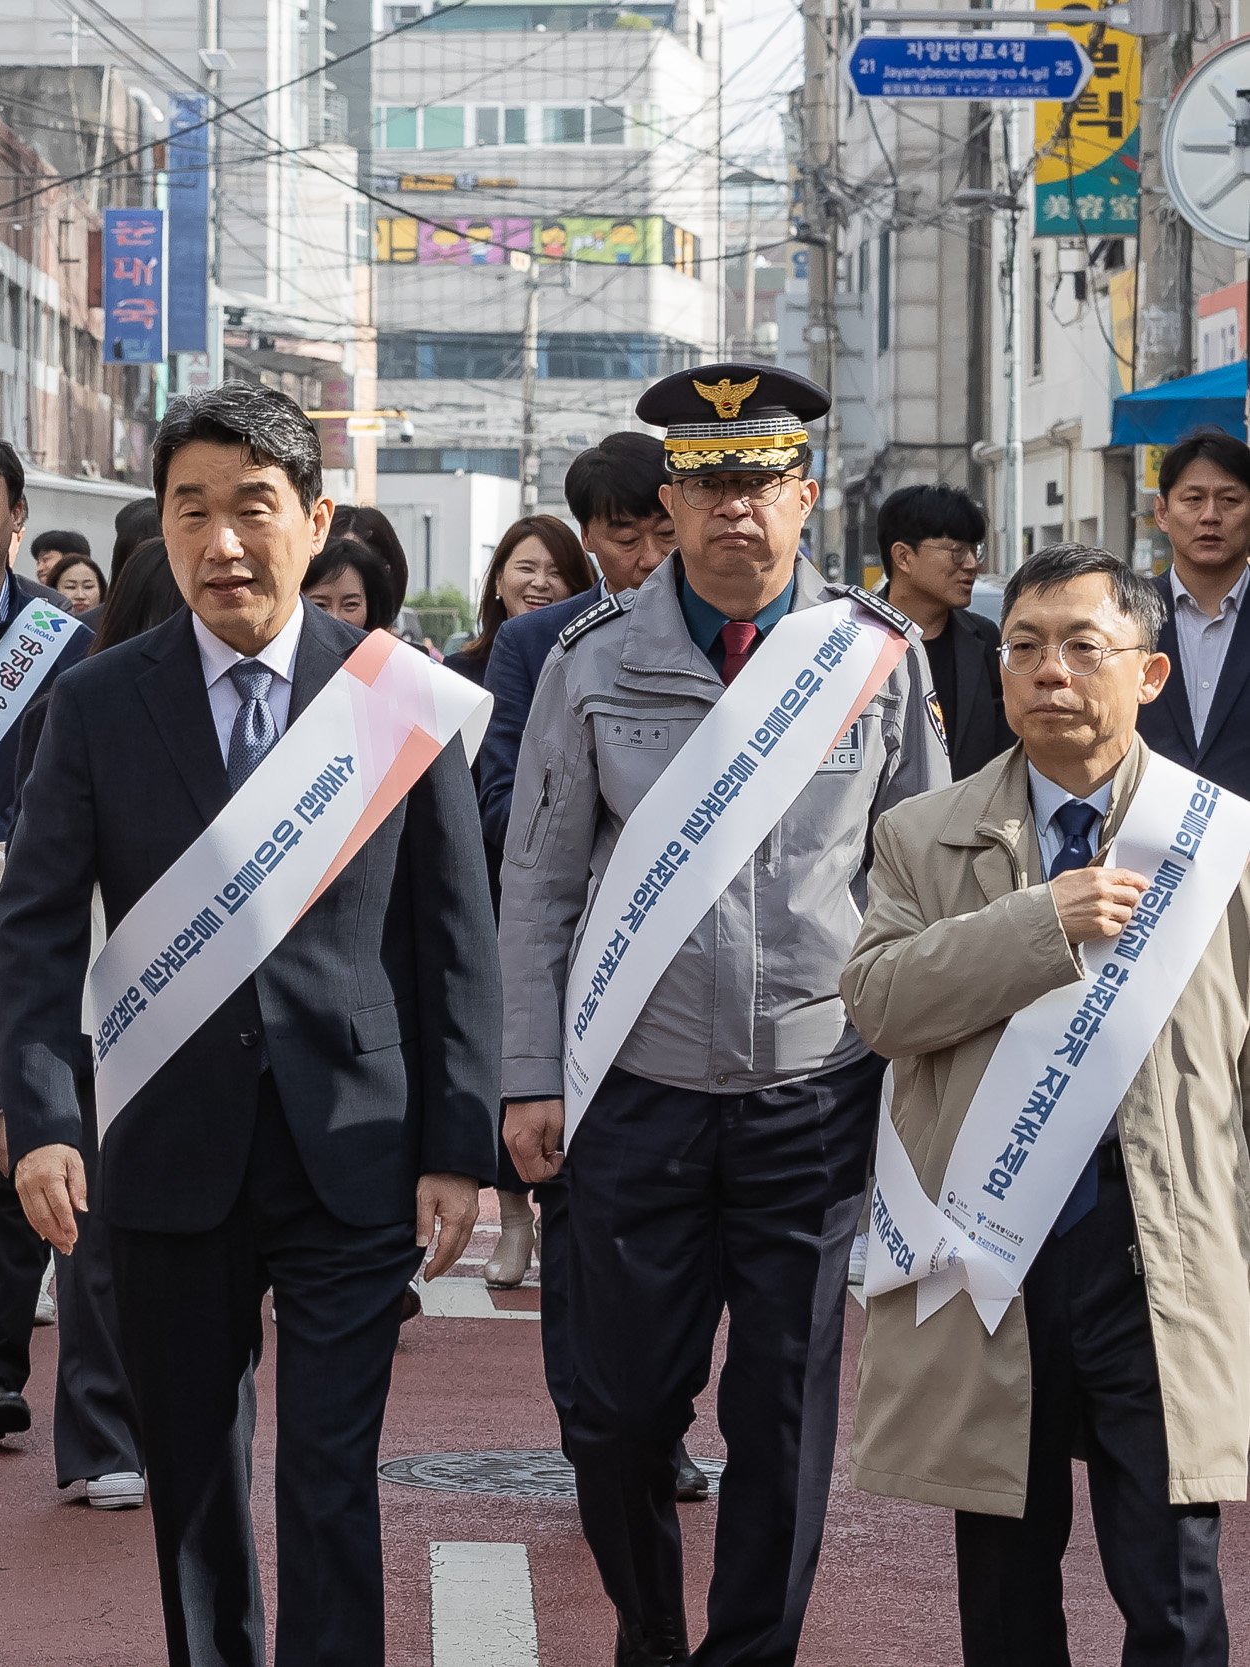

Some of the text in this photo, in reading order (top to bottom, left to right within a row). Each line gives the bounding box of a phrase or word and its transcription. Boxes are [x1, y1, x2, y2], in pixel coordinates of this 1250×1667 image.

[859, 58, 877, 75] 21
[1019, 66, 1049, 82] 4-gil
[1055, 60, 1074, 76] 25
[23, 623, 55, 643] KoROAD
[747, 669, 822, 757] 아이들의
[294, 755, 354, 824] 소중한
[680, 752, 758, 845] 등하굣길
[1170, 780, 1220, 861] 아이들의
[214, 820, 302, 916] 아이들의
[621, 841, 691, 933] 안전하게
[140, 908, 225, 995] 등하굣길
[1053, 963, 1129, 1067] 안전하게
[982, 1065, 1071, 1201] 지켜주세요
